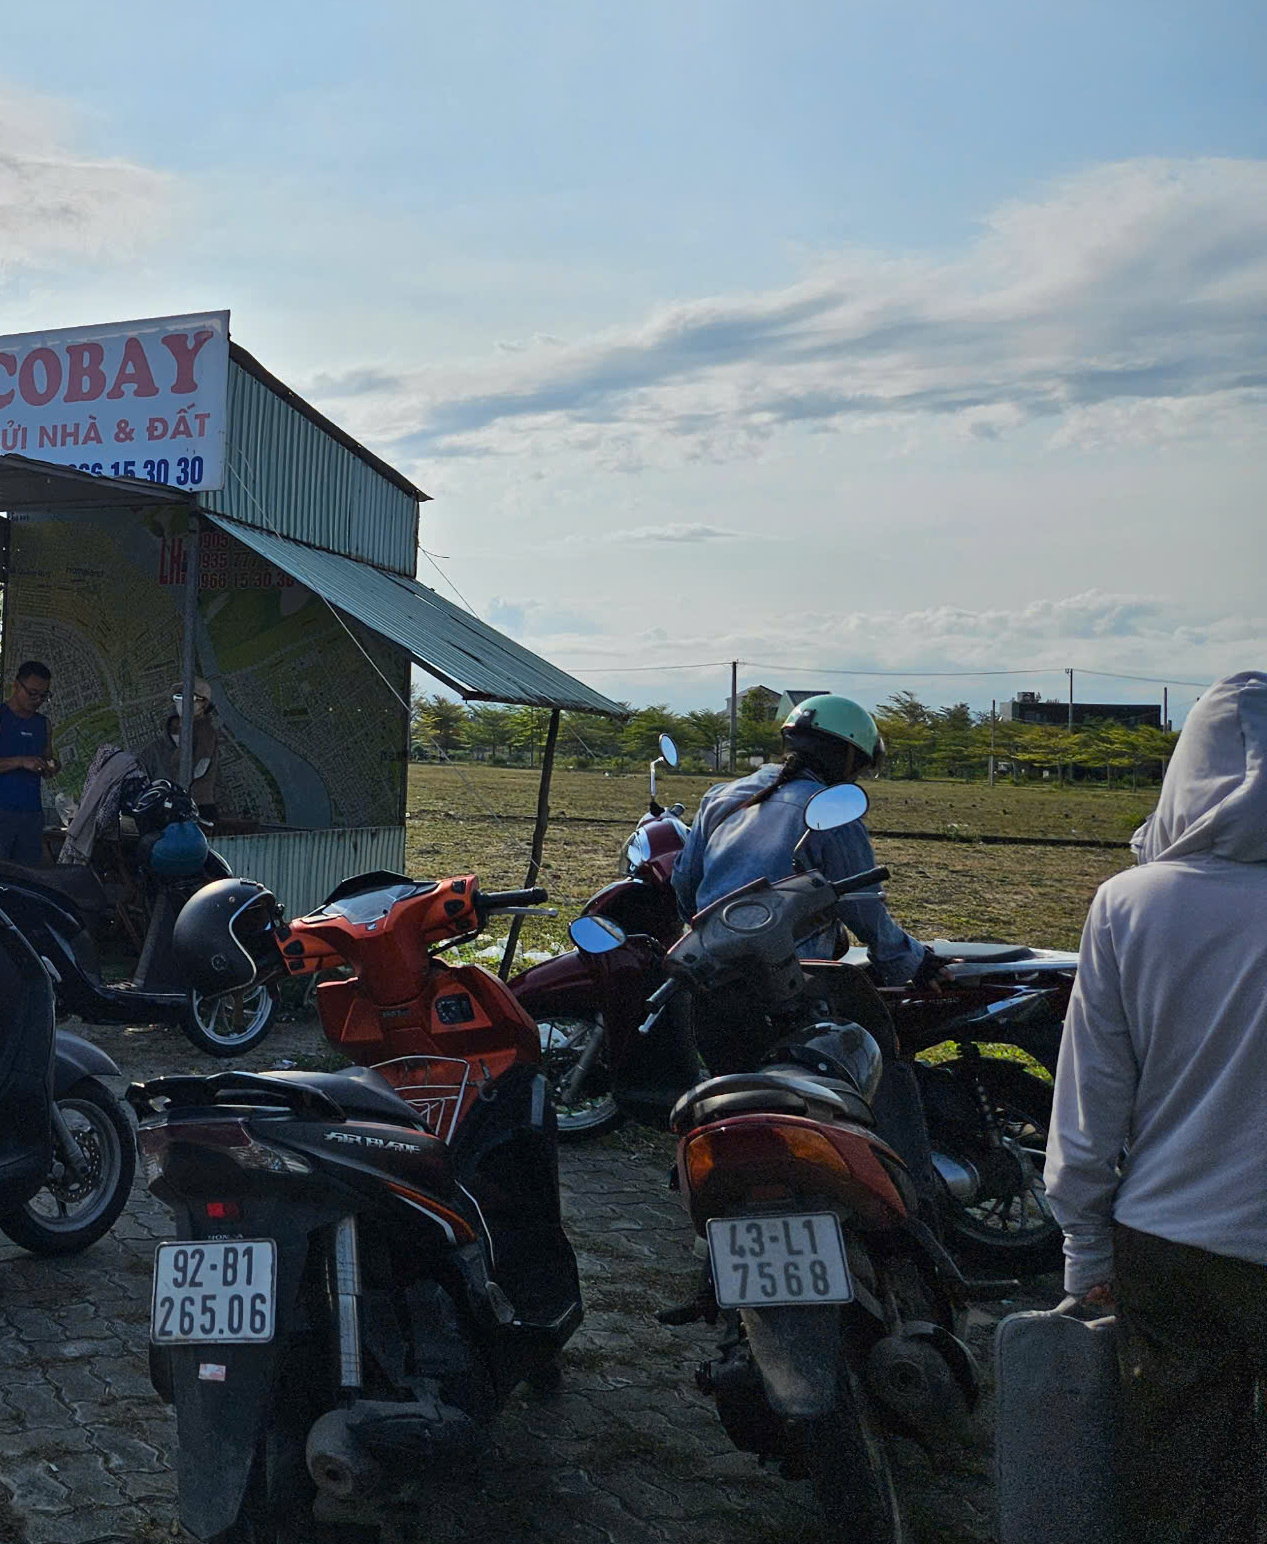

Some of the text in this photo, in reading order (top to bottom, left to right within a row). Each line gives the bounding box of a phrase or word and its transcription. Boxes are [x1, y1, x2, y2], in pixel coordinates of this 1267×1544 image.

[38, 414, 103, 448] NHÀ
[113, 418, 136, 443] &
[146, 403, 211, 442] ĐẤT
[143, 458, 170, 485] 30
[176, 455, 205, 485] 30
[730, 1219, 818, 1258] 43-L1
[172, 1245, 254, 1288] 92-B1
[732, 1260, 829, 1300] 7568
[158, 1292, 267, 1337] 265.06
